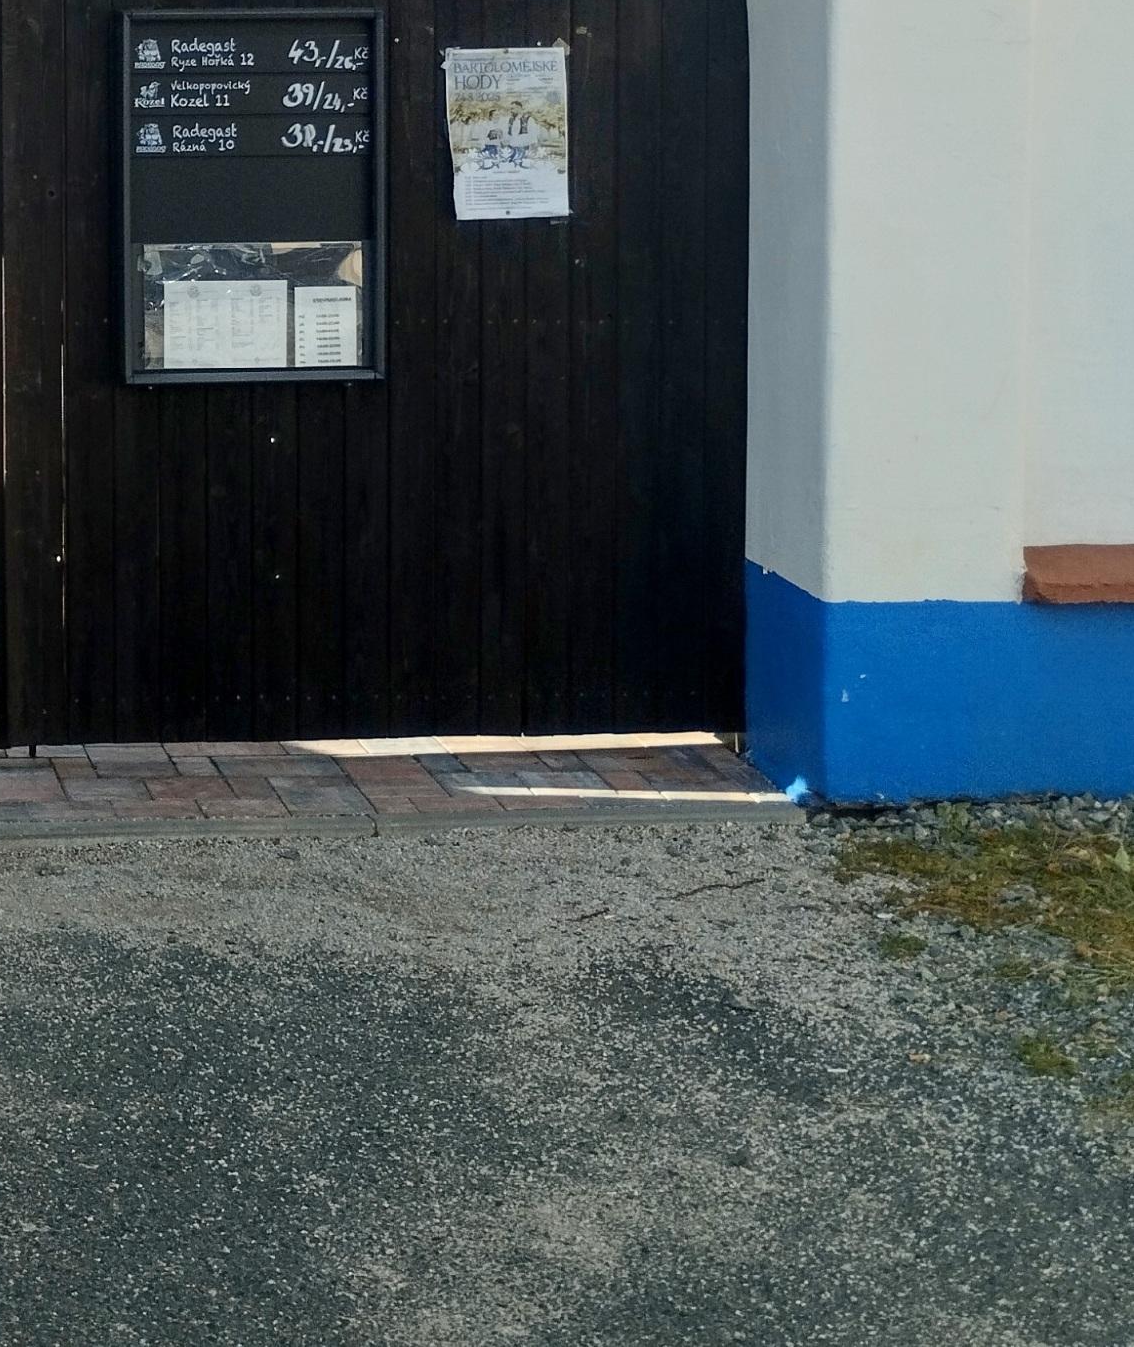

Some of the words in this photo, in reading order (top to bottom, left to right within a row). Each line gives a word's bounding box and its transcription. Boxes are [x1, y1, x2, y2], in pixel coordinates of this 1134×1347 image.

[171, 37, 236, 57] Radegast
[354, 46, 369, 59] Kč
[202, 54, 234, 66] Hořká
[240, 53, 255, 66] 12
[170, 80, 251, 95] Velkopopovický
[454, 74, 502, 90] HODY
[170, 93, 210, 108] Kozel
[215, 94, 230, 107] 11
[353, 87, 368, 100] Kč
[172, 123, 237, 142] Radegast
[355, 129, 370, 143] Kč
[172, 139, 207, 153] Rázná
[218, 139, 235, 151] 10
